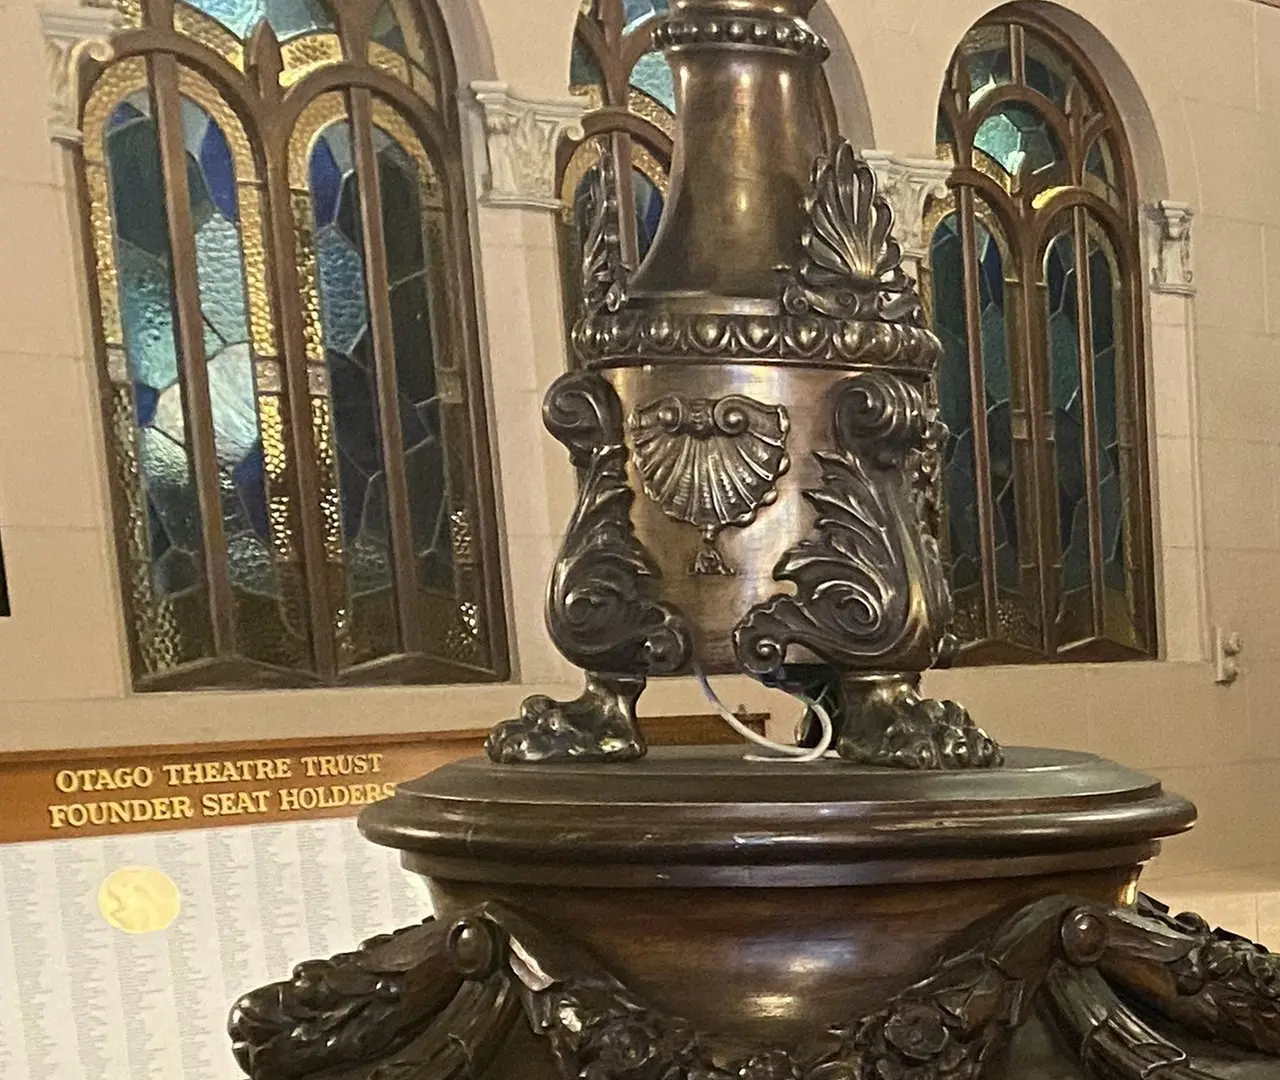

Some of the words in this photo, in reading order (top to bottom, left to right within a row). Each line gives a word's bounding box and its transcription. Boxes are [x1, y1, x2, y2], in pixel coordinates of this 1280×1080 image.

[55, 766, 152, 793] OTAGO
[162, 758, 292, 786] THEATRE
[301, 753, 384, 777] TRUST
[48, 796, 194, 828] FOUNDER
[202, 791, 270, 817] SEAT
[278, 782, 397, 811] HOLDERS
